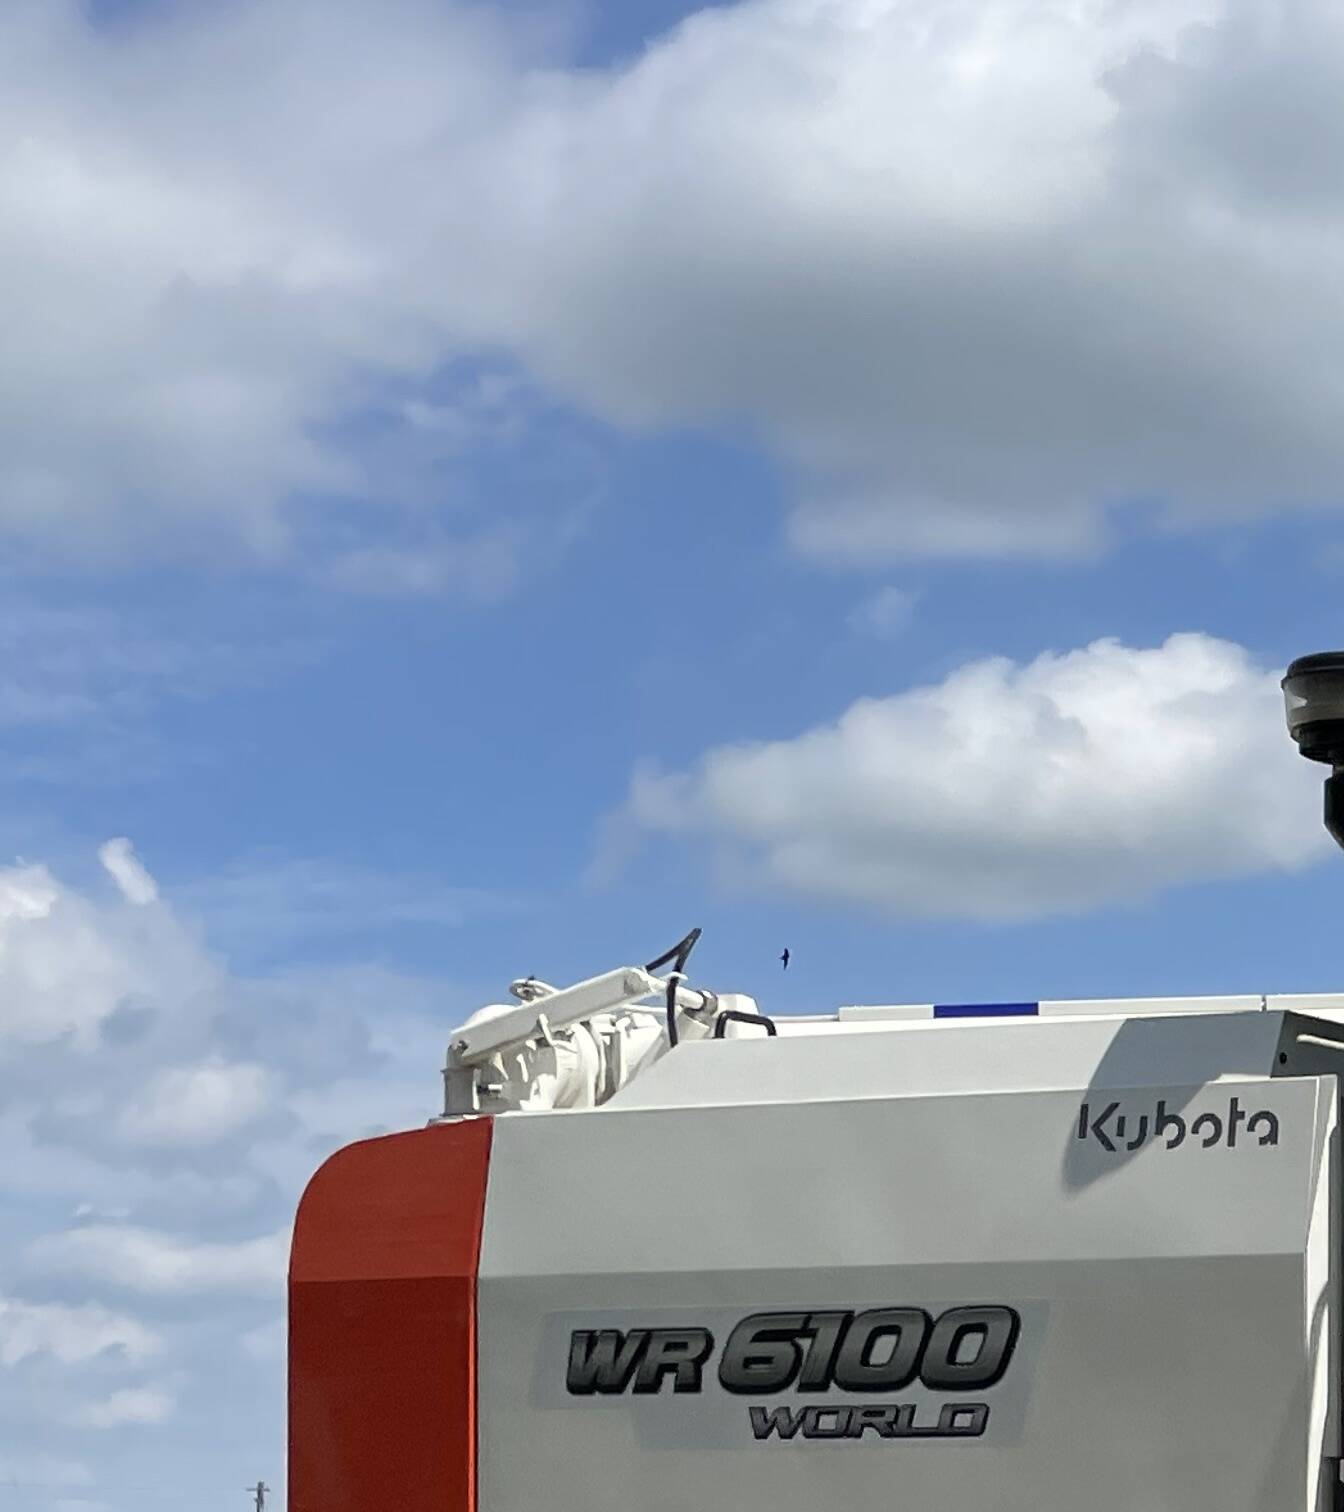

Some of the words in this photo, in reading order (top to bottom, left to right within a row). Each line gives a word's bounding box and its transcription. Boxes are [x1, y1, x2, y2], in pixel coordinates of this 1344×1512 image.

[1078, 1097, 1279, 1152] Kubota
[566, 1327, 715, 1395] WR
[718, 1305, 1022, 1394] 6100
[748, 1402, 990, 1439] WORLD
